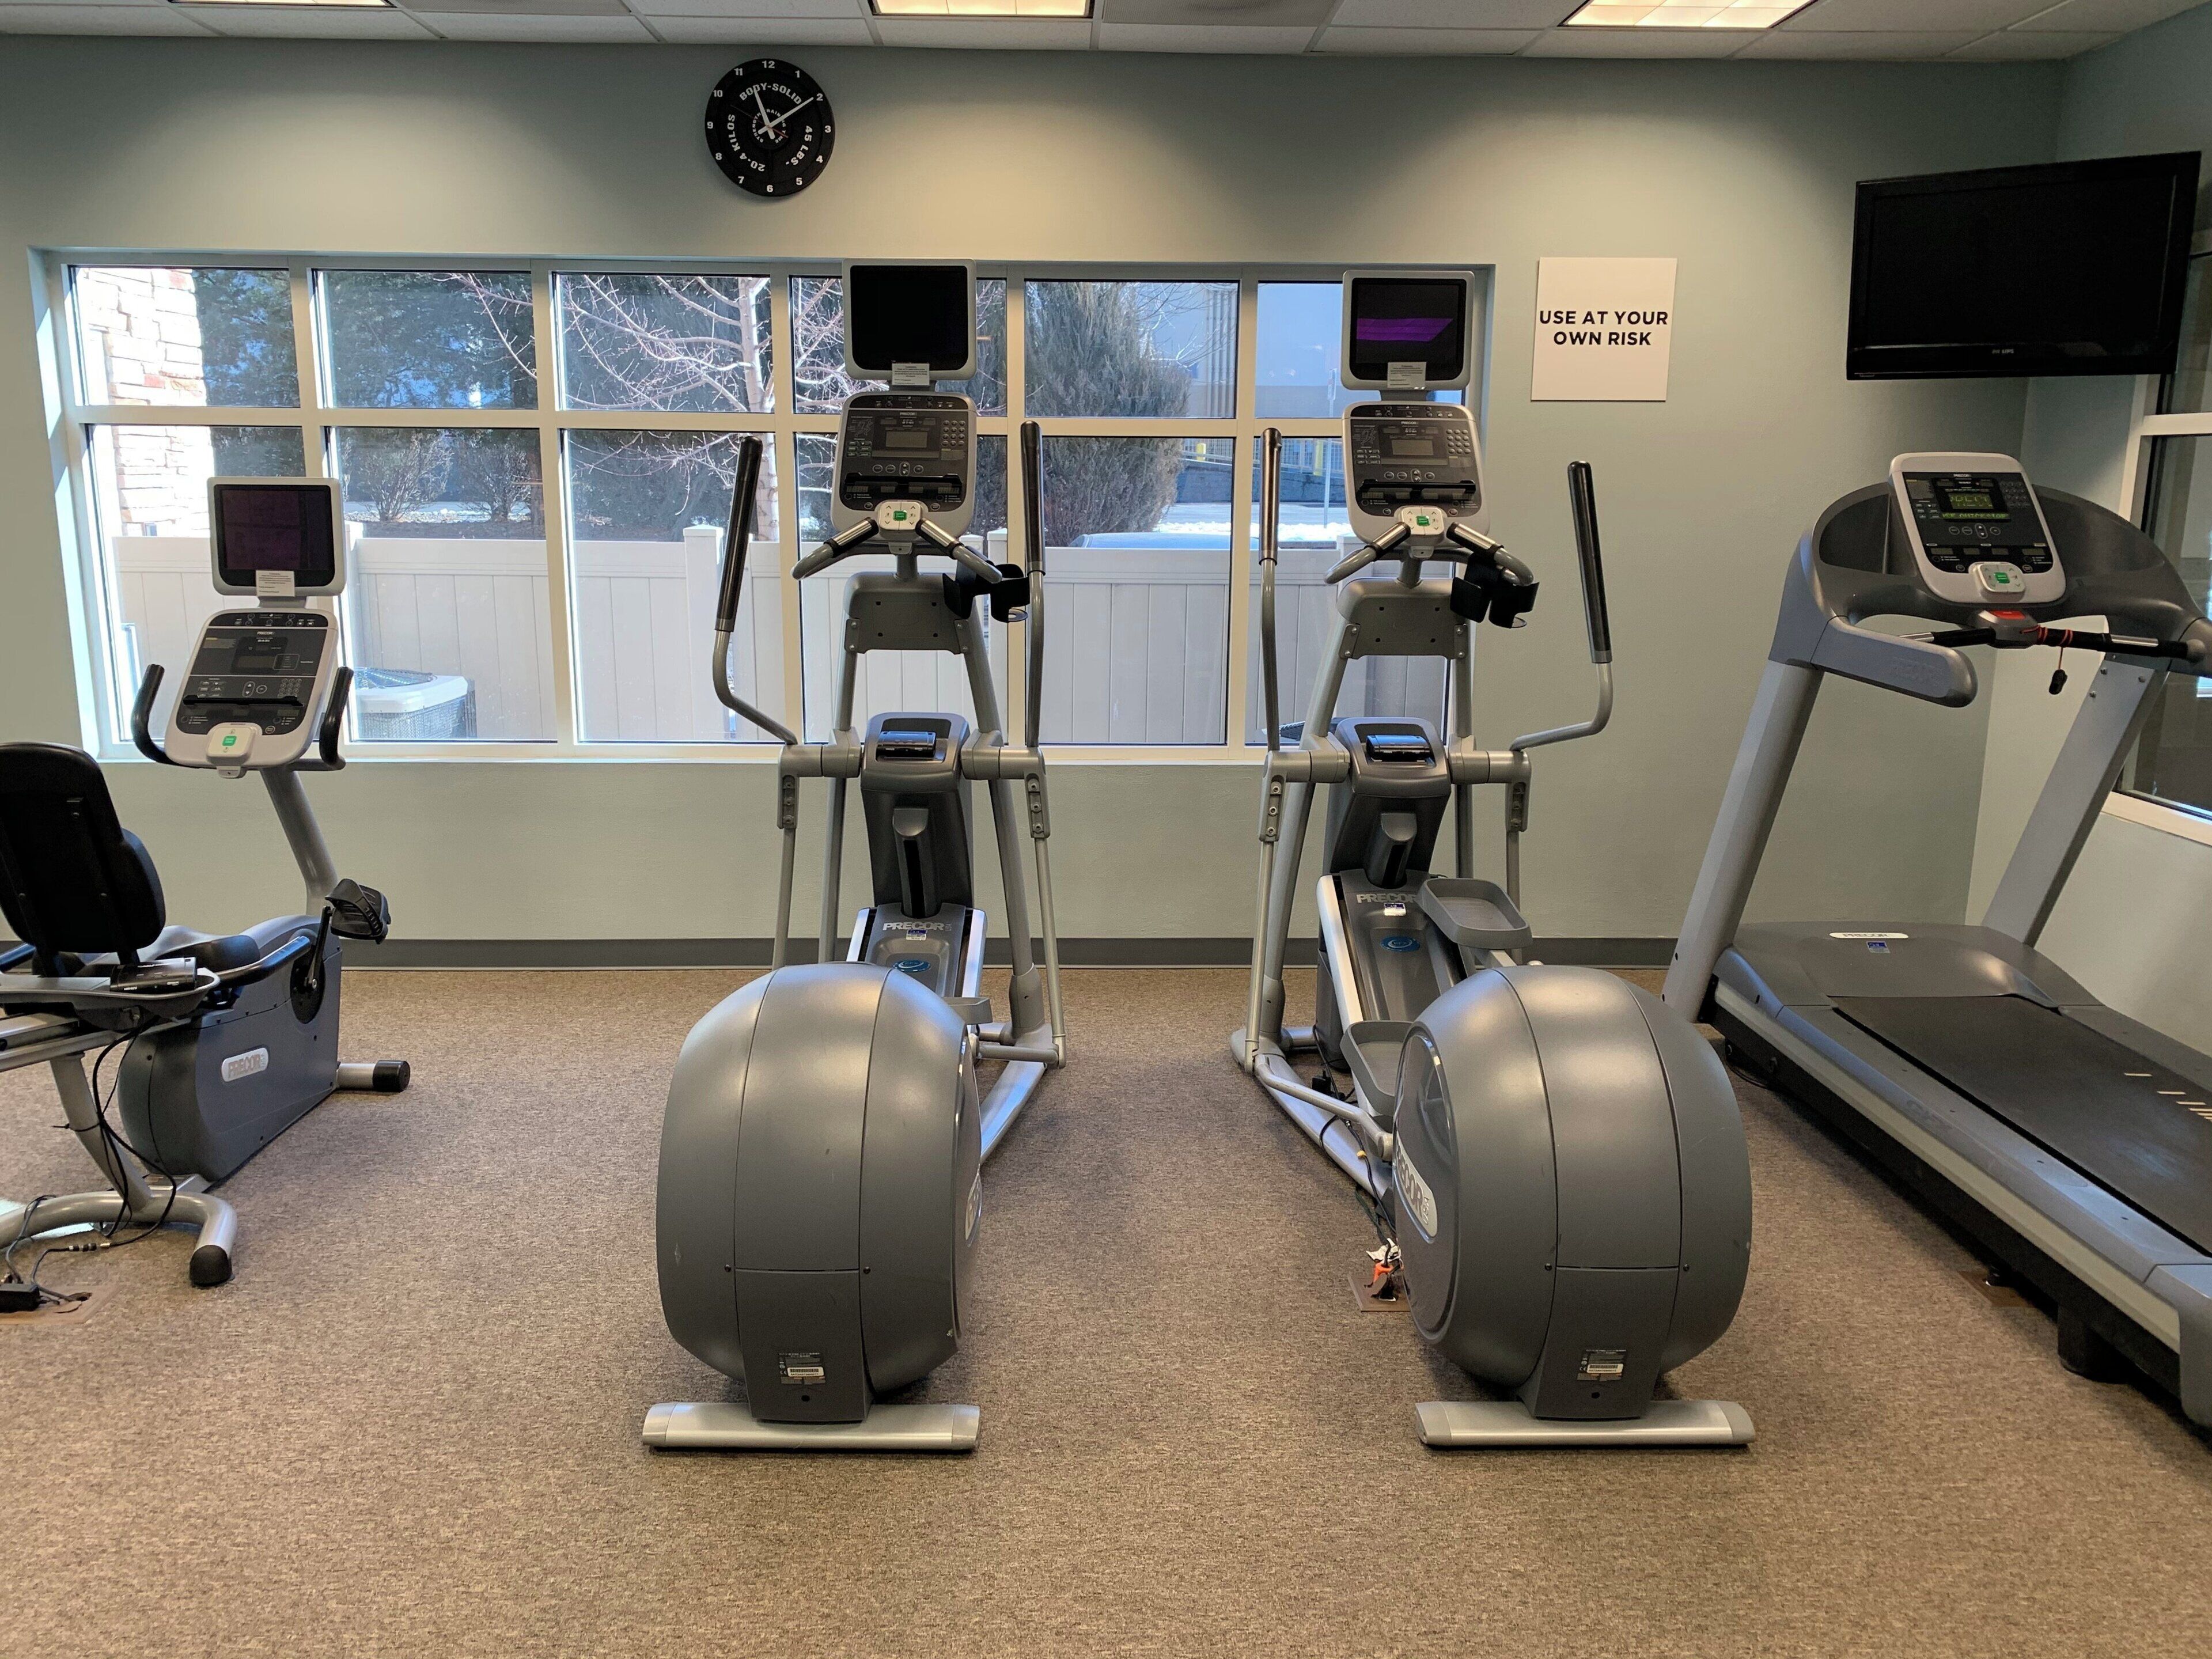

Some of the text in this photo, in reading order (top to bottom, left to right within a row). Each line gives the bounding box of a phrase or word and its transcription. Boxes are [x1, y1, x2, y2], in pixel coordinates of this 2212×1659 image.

[734, 68, 743, 76] 11
[762, 60, 775, 69] 12
[739, 82, 802, 104] BODY-SOLID
[727, 114, 741, 151] KILOS
[804, 125, 813, 142] 45
[740, 153, 766, 172] 20.4
[1539, 310, 1668, 325] USE AT YOUR
[1554, 331, 1652, 346] OWN RISK
[882, 922, 945, 930] PRECOR
[228, 1054, 262, 1079] PRECOR
[1396, 1139, 1423, 1219] RECOR
